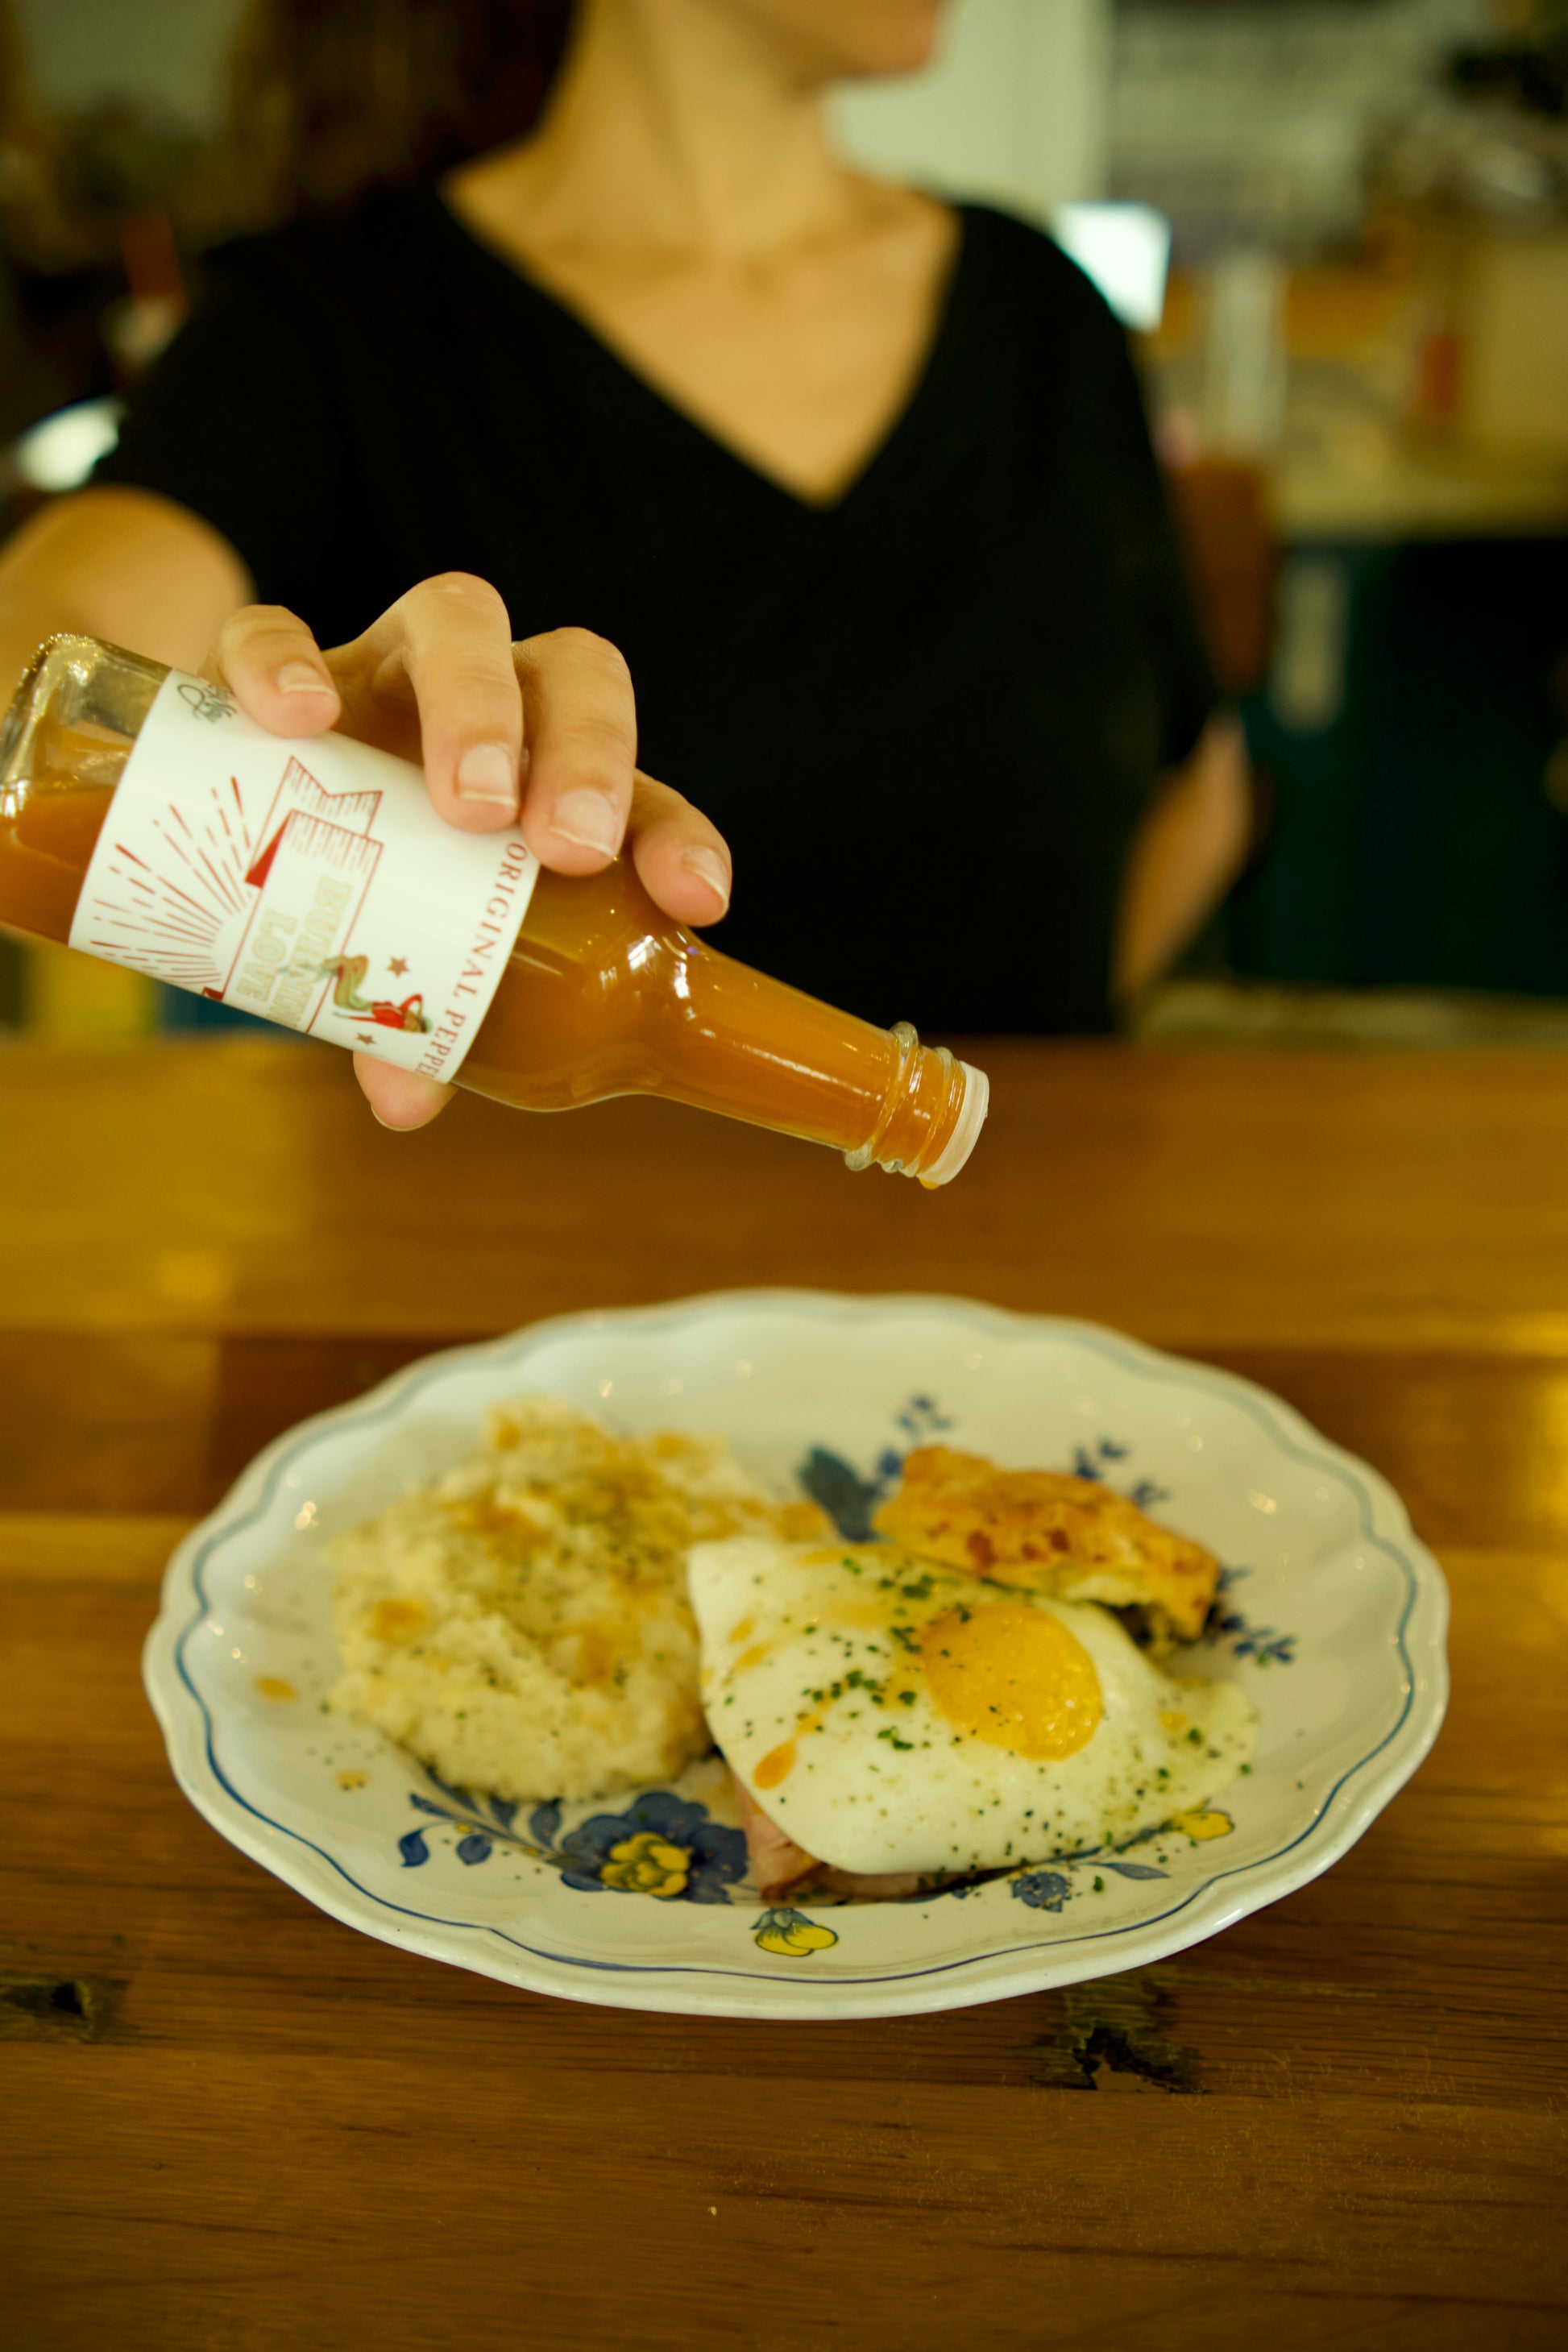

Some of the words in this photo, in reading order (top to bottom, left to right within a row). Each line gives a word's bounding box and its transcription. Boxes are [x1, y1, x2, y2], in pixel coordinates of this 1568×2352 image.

[236, 907, 298, 1002] LOVE
[266, 874, 355, 1029] BURNIN
[453, 842, 528, 998] ORIGINAL
